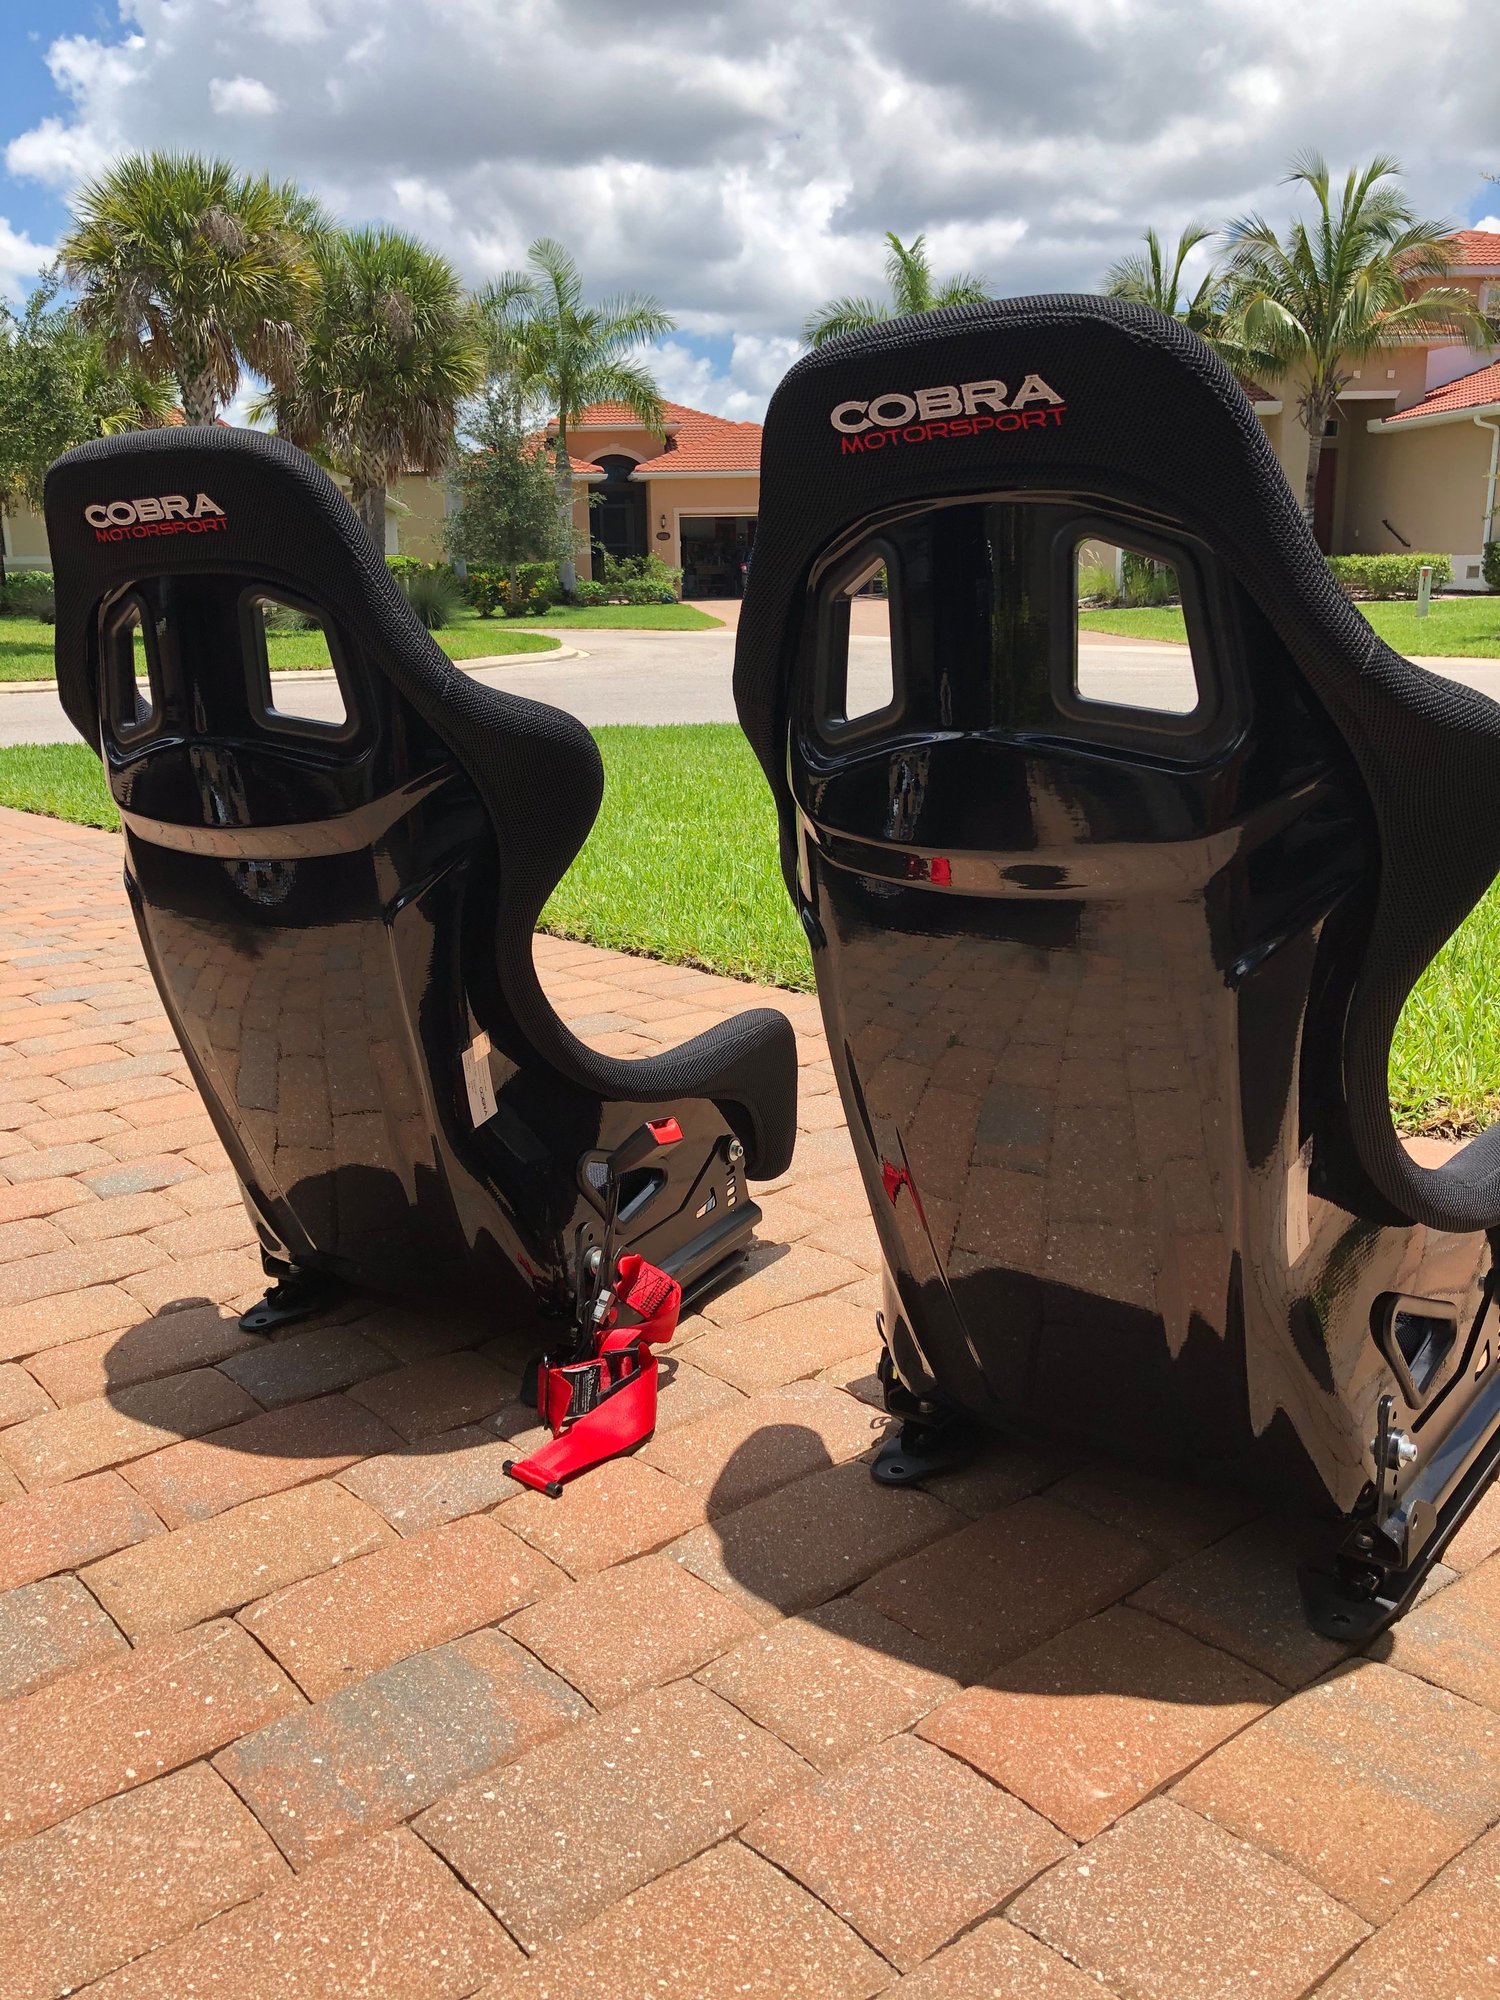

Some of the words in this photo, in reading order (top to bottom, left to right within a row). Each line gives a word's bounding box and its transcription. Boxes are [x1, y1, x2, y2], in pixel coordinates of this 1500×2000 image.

[830, 373, 1065, 434] COBRA
[840, 406, 1067, 455] MOTORSPORT
[84, 493, 226, 529] COBRA
[95, 517, 228, 543] MOTORSPORT
